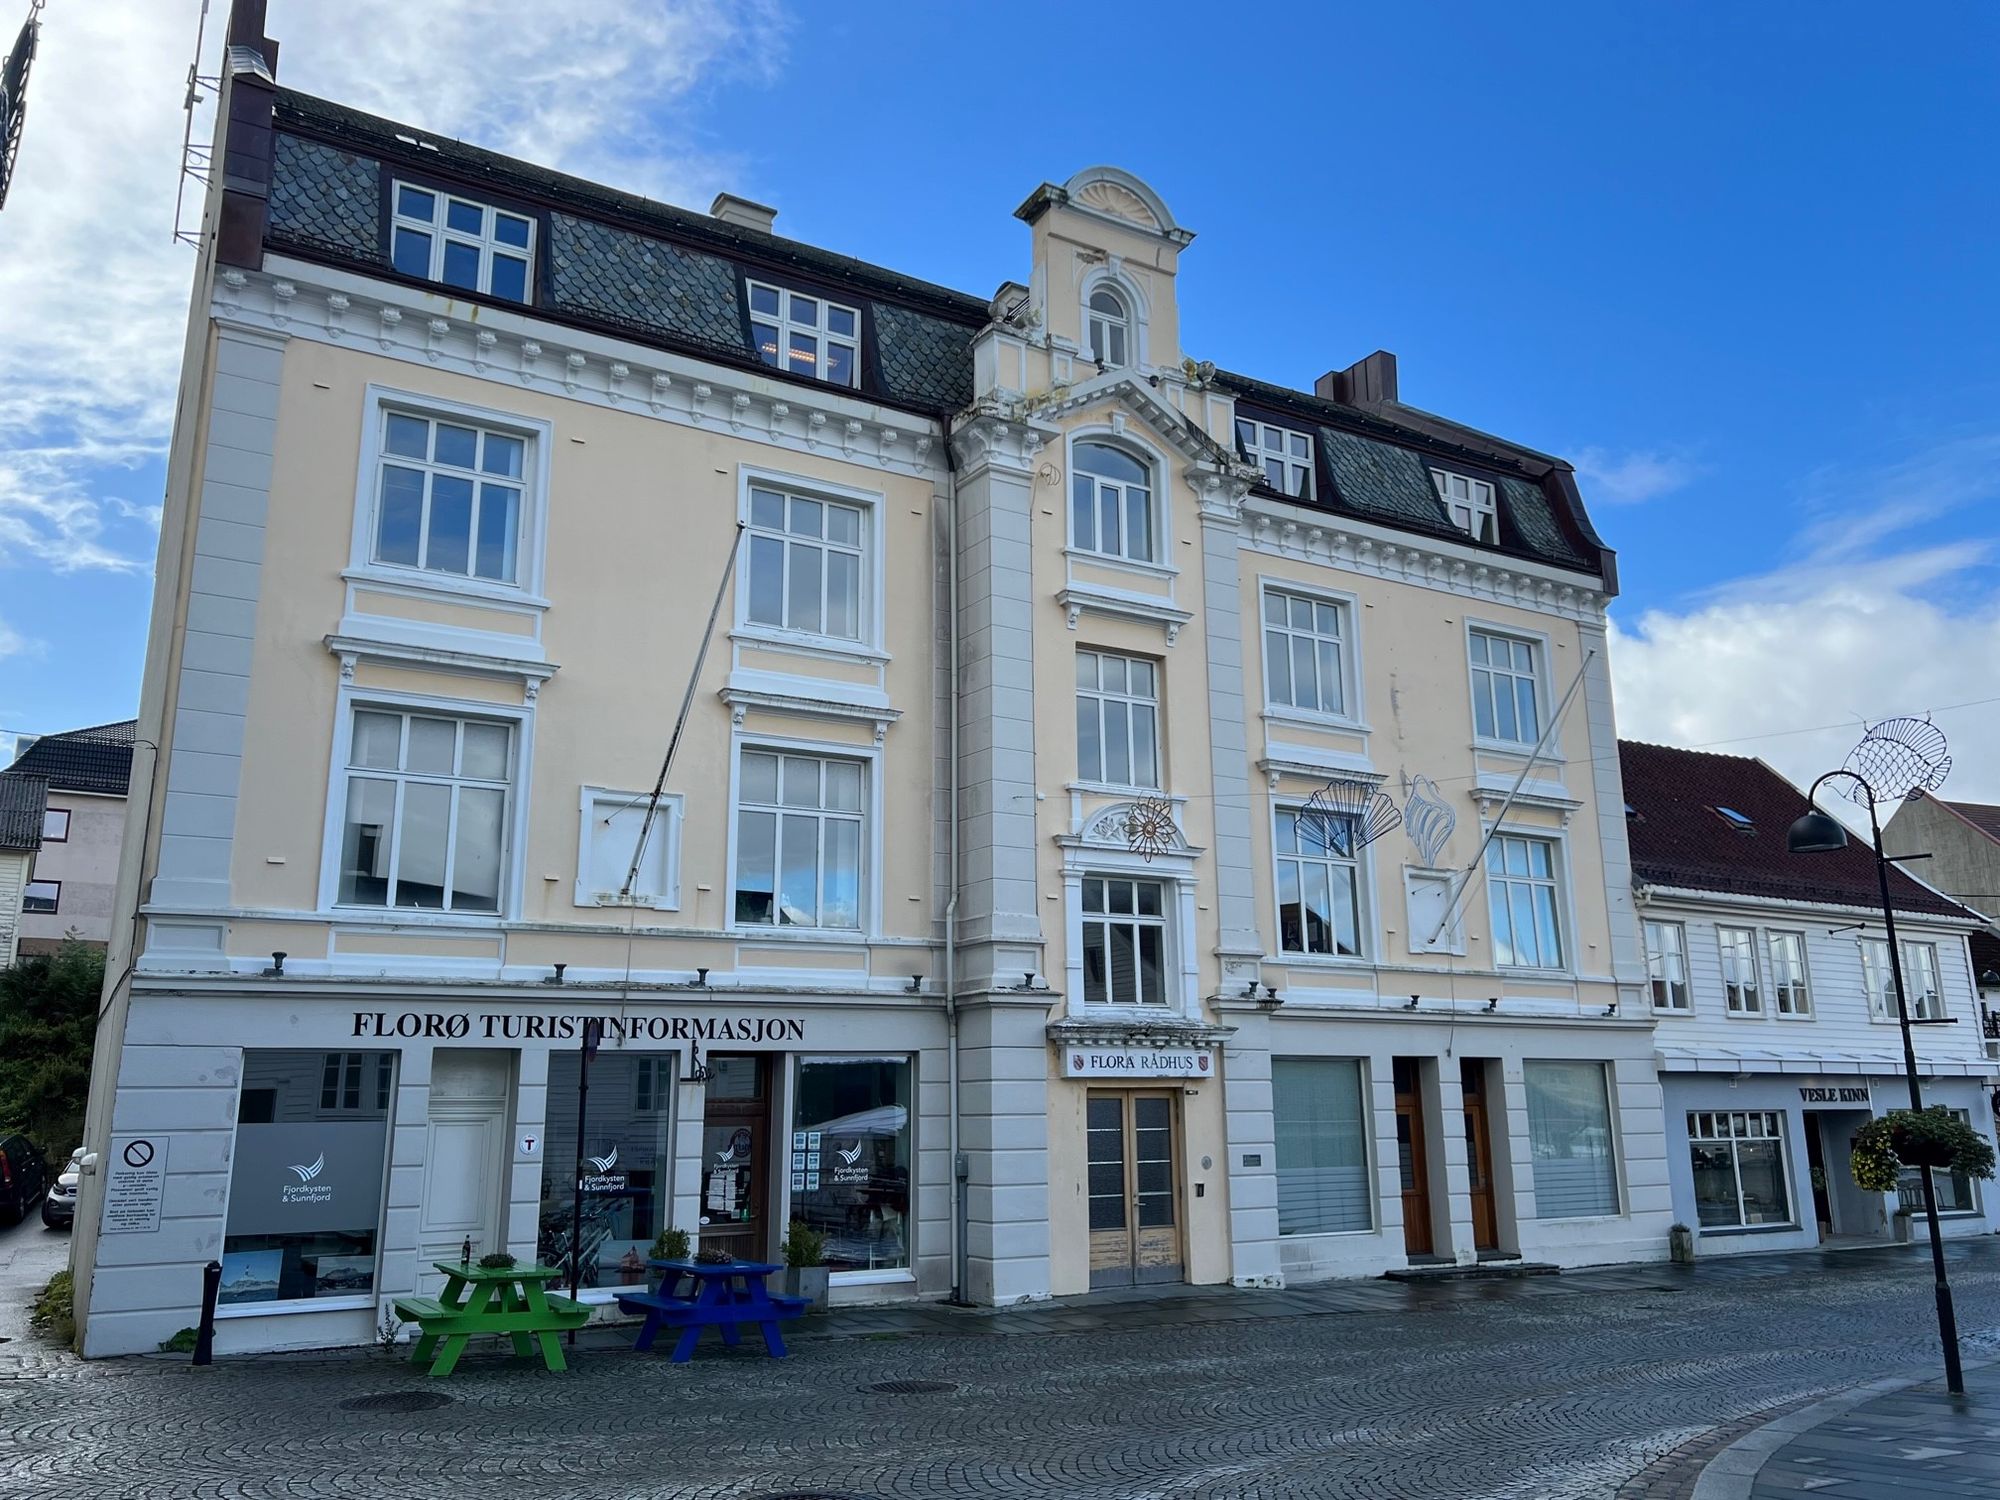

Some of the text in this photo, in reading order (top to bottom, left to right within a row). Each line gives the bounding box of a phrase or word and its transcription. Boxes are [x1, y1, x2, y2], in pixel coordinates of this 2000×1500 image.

[353, 1012, 805, 1043] FLORØ TURISTINFORMASJON
[1091, 1053, 1193, 1070] FLORA RÅDHUS
[1799, 1087, 1869, 1102] VESLE KINN
[525, 1139, 535, 1151] T
[834, 1166, 869, 1175] Fjordkysten
[584, 1175, 625, 1184] Fjordkysten
[840, 1174, 868, 1183] Sunnfjord
[283, 1185, 332, 1195] Fjordkysten
[591, 1183, 625, 1193] Sunnfjord
[282, 1193, 331, 1203] & Sunnfjord
